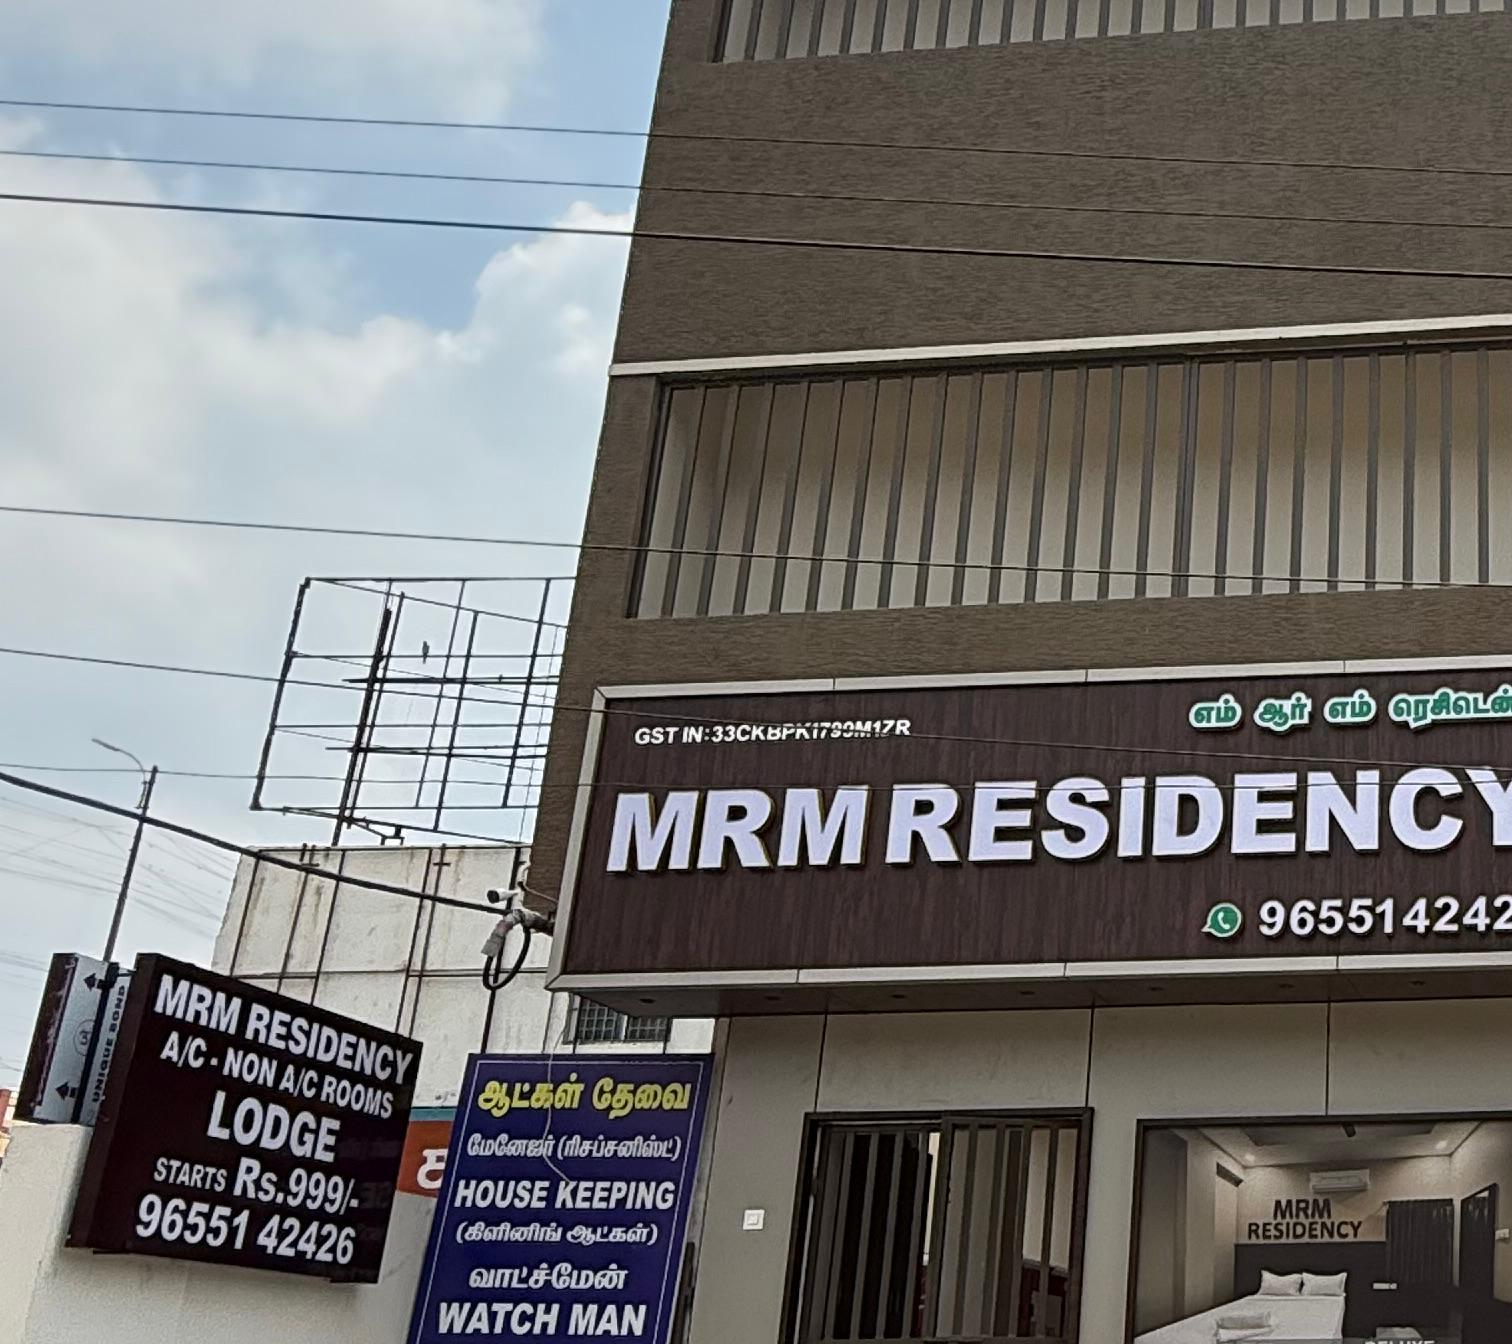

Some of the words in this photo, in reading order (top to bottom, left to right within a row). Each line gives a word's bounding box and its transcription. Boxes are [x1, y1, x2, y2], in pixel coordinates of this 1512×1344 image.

[1191, 694, 1241, 728] எம்
[1255, 694, 1311, 731] ஆர்
[1325, 690, 1376, 723] எம்
[635, 726, 679, 745] GST
[607, 784, 870, 872] MRM
[154, 973, 243, 1035] MRM
[244, 1002, 414, 1086] RESIDENCY
[160, 1030, 208, 1069] A/C
[222, 1046, 277, 1090] NON
[278, 1066, 319, 1099] A/C
[320, 1075, 395, 1120] ROOMS
[477, 1072, 584, 1119] ஆட்கள்
[592, 1077, 693, 1120] தேவை
[206, 1090, 342, 1163] LODGE
[153, 1157, 227, 1192] STARTS
[233, 1157, 360, 1215] Rs.999/-
[454, 1179, 549, 1208] HOUSE
[555, 1179, 676, 1210] KEEPING
[1273, 1198, 1333, 1221] MRM
[135, 1193, 251, 1251] 96551
[256, 1214, 357, 1265] 42426
[1247, 1221, 1363, 1240] RESIDENCY
[438, 1302, 561, 1336] WATCH
[567, 1303, 648, 1337] MAN
